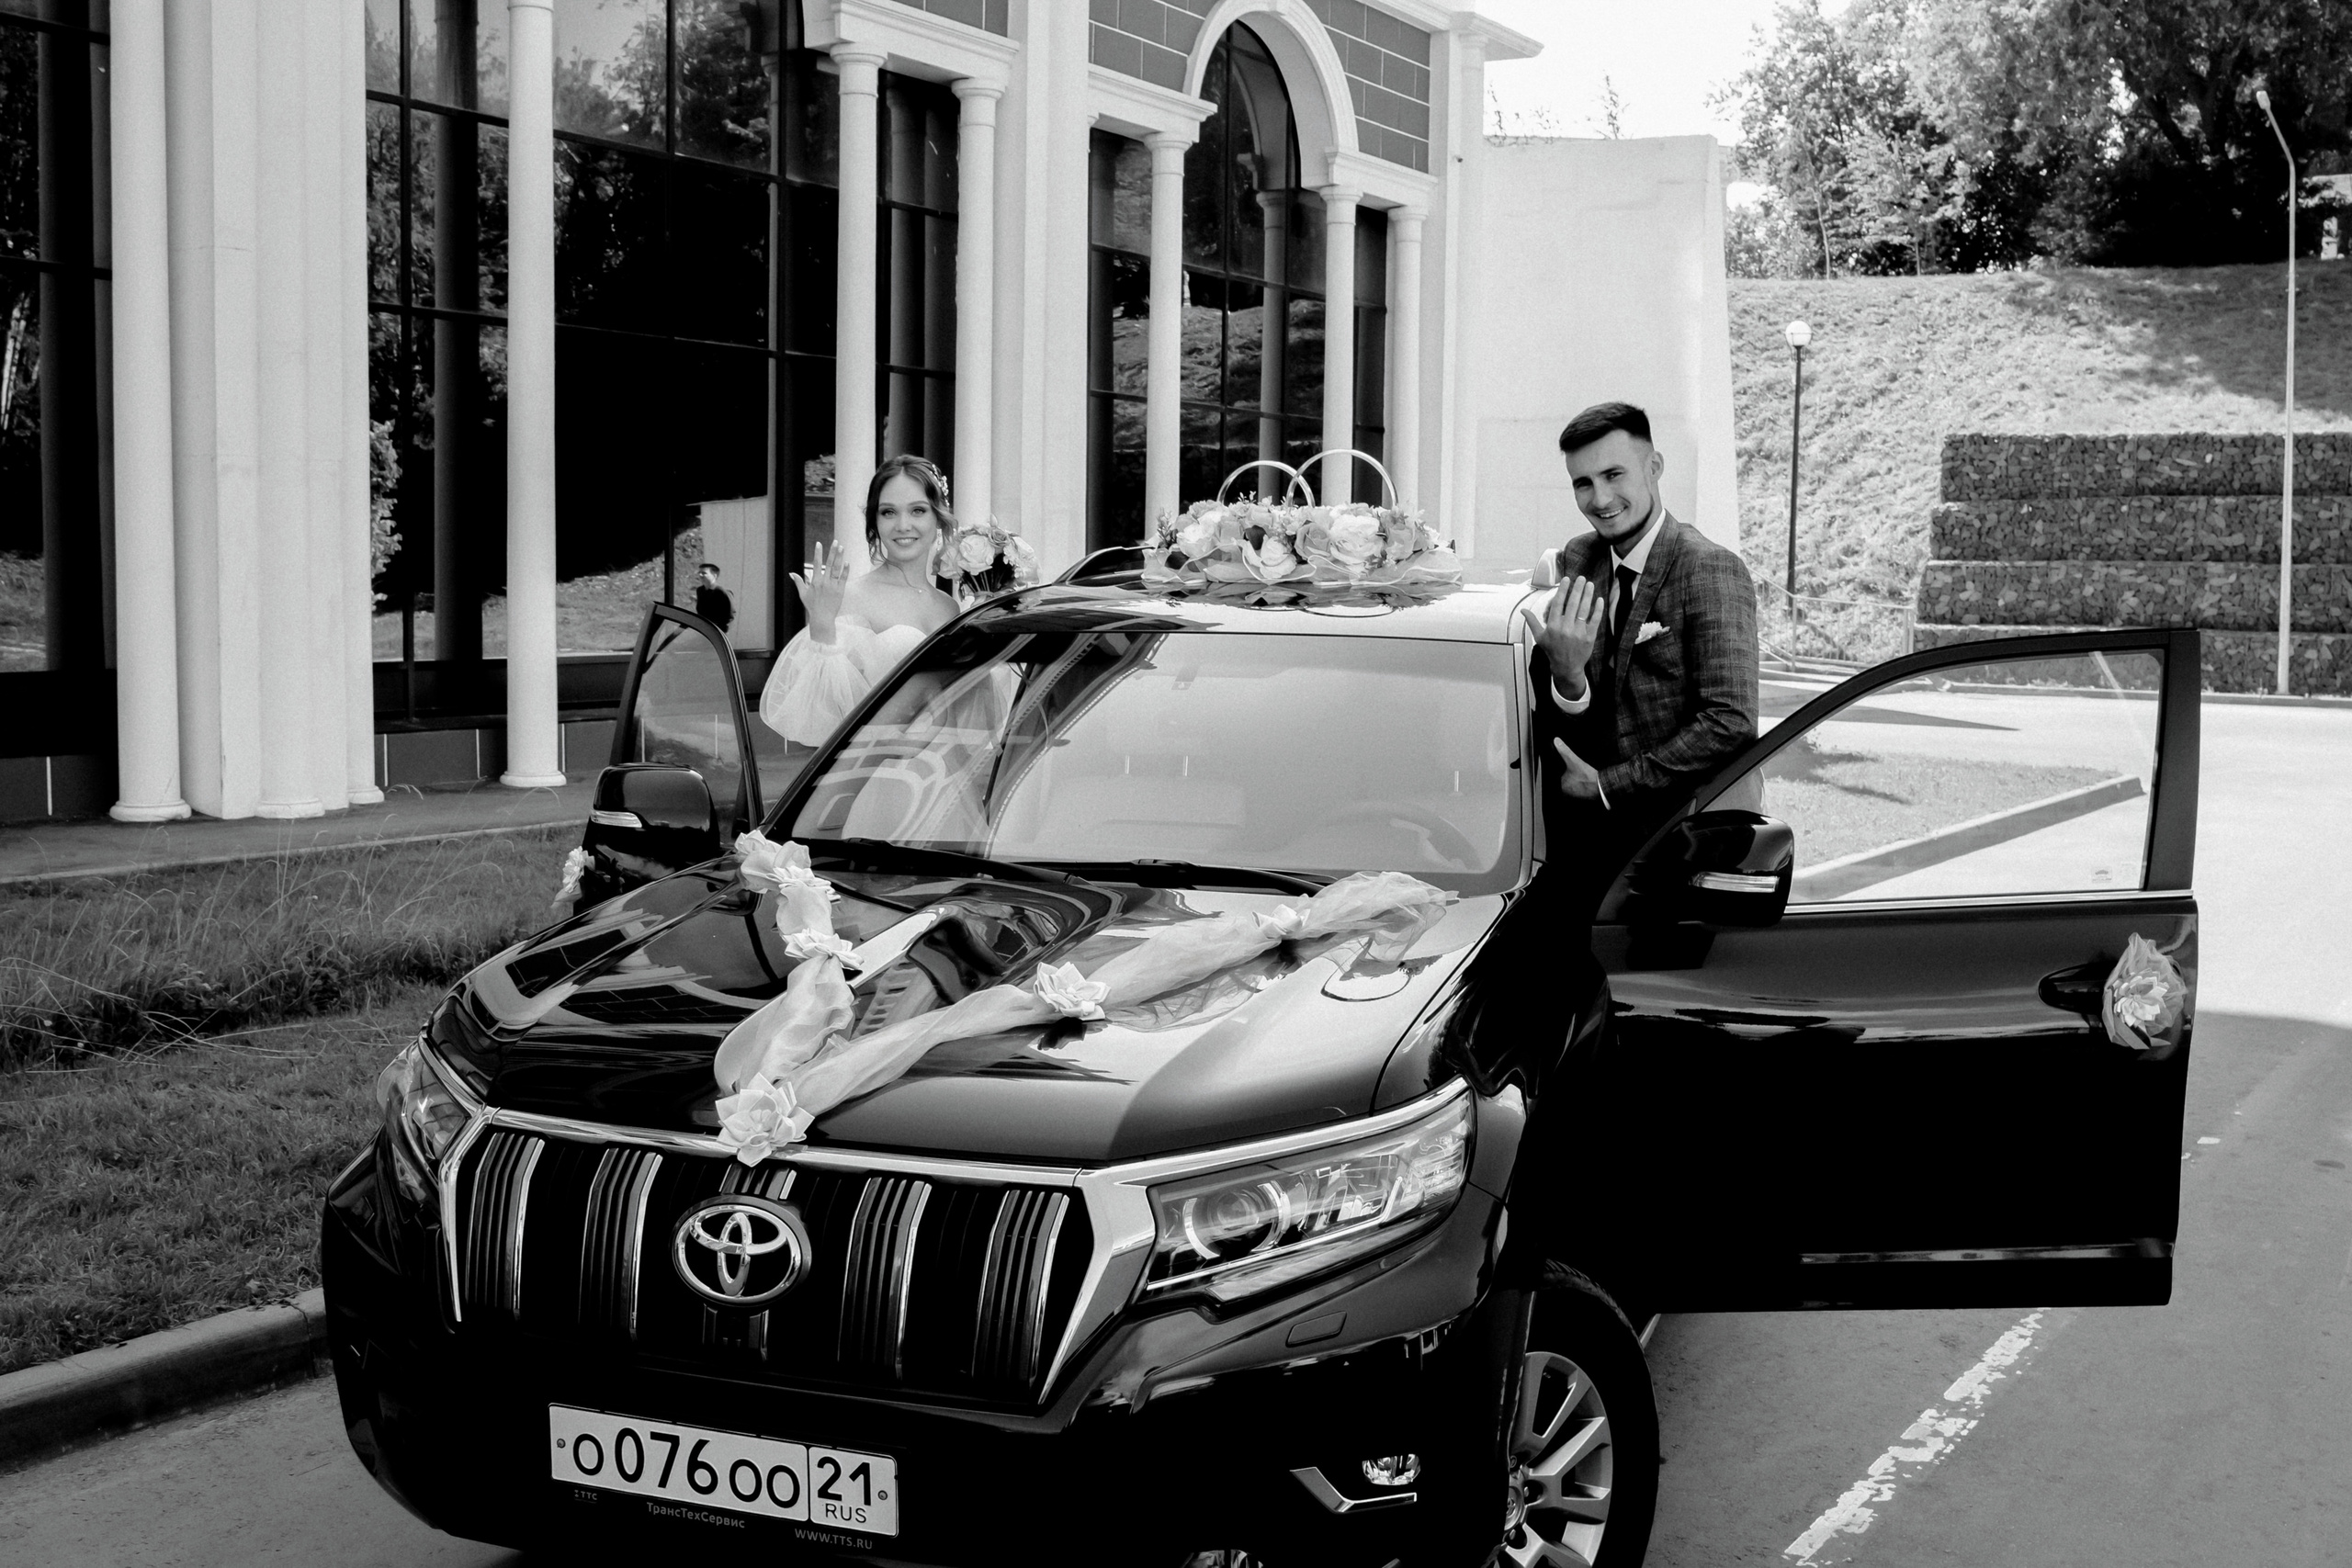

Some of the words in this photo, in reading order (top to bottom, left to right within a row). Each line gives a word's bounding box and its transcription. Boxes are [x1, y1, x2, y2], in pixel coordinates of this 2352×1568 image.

[817, 1456, 872, 1506] 21
[646, 1501, 745, 1529] ТрансТехСервис
[825, 1503, 867, 1524] RUS
[794, 1528, 873, 1550] WWW.TTS.RU
